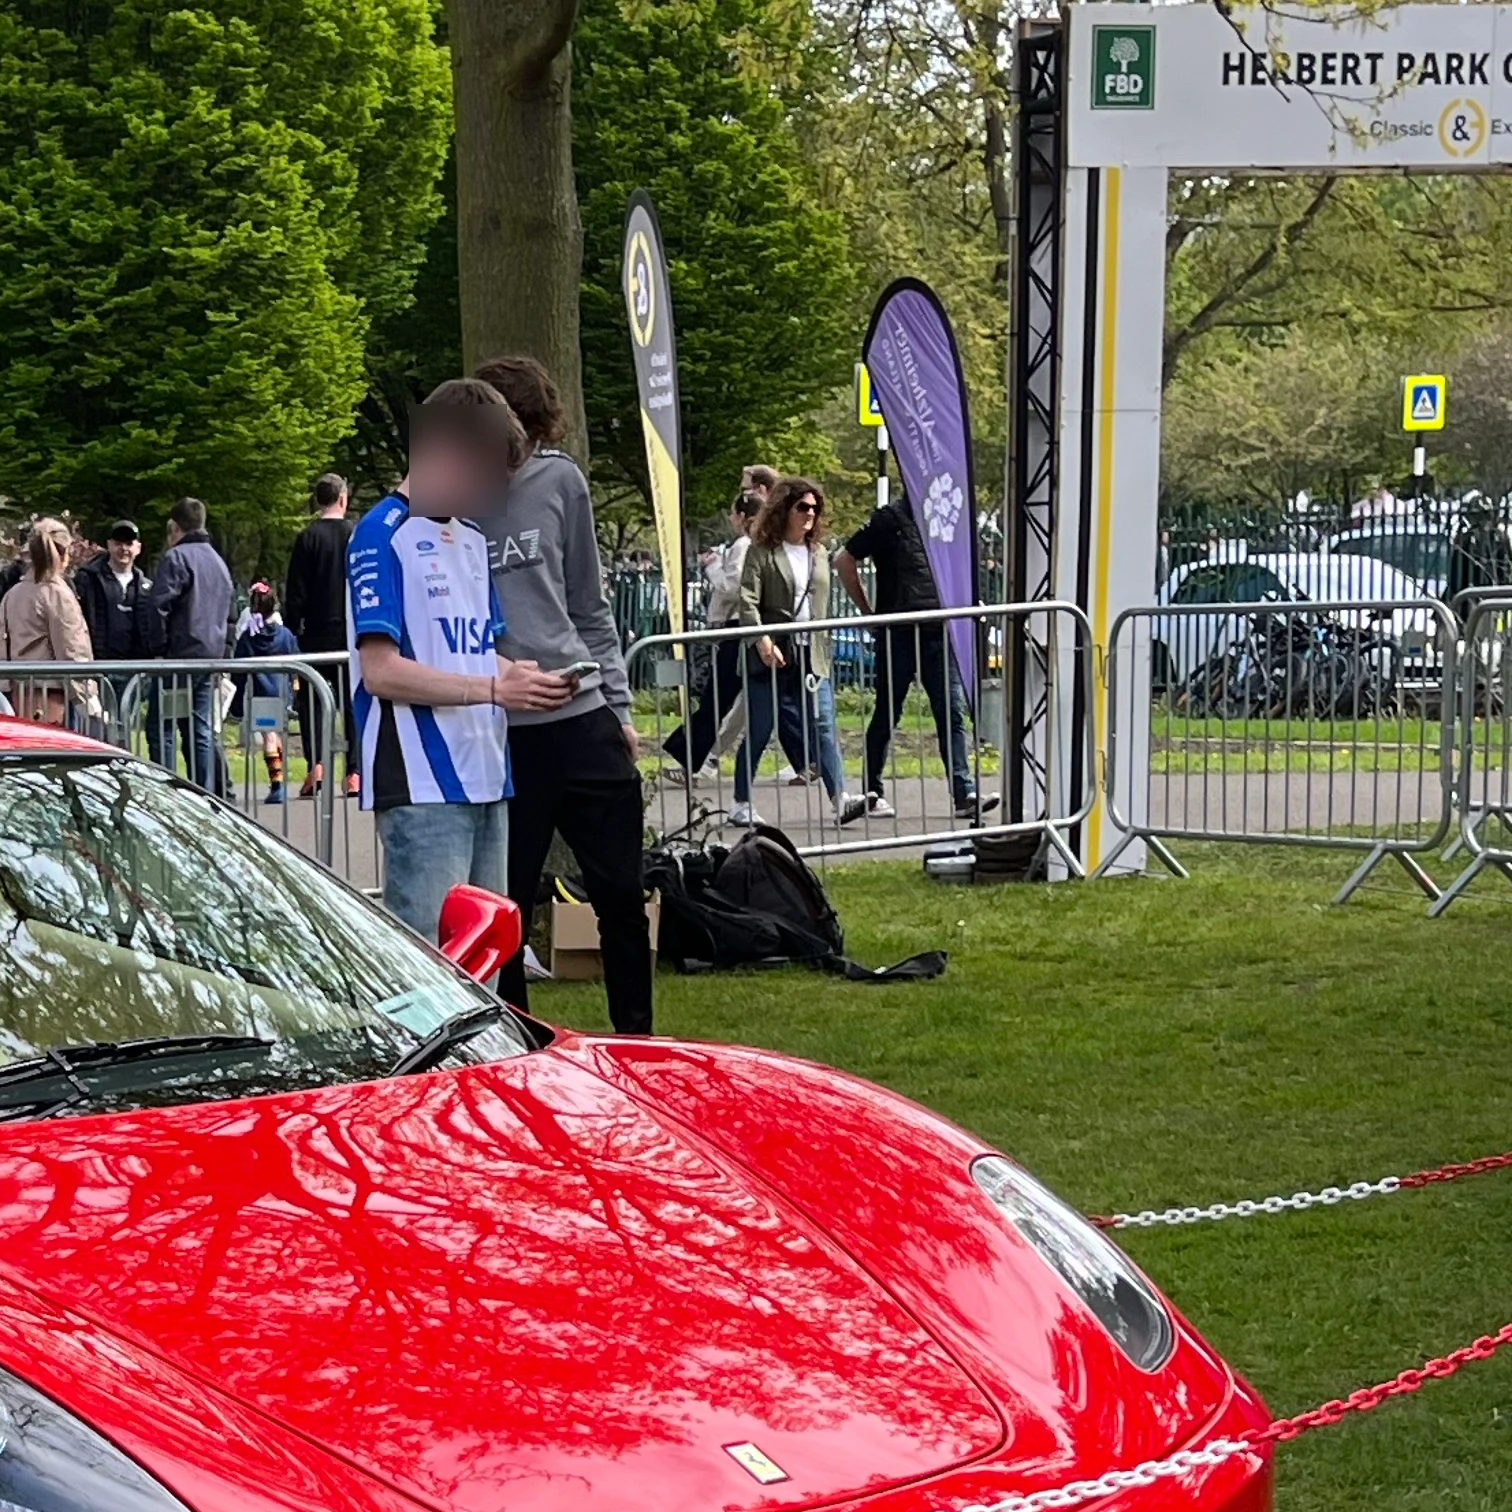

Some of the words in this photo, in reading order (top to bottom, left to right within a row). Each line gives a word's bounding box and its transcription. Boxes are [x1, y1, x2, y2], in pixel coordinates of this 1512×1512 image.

[1222, 52, 1384, 86] HERBERT
[1396, 51, 1490, 86] PARK
[1105, 74, 1143, 94] FBD
[1370, 120, 1434, 137] Classic
[1452, 115, 1470, 141] &
[433, 617, 495, 655] VISA
